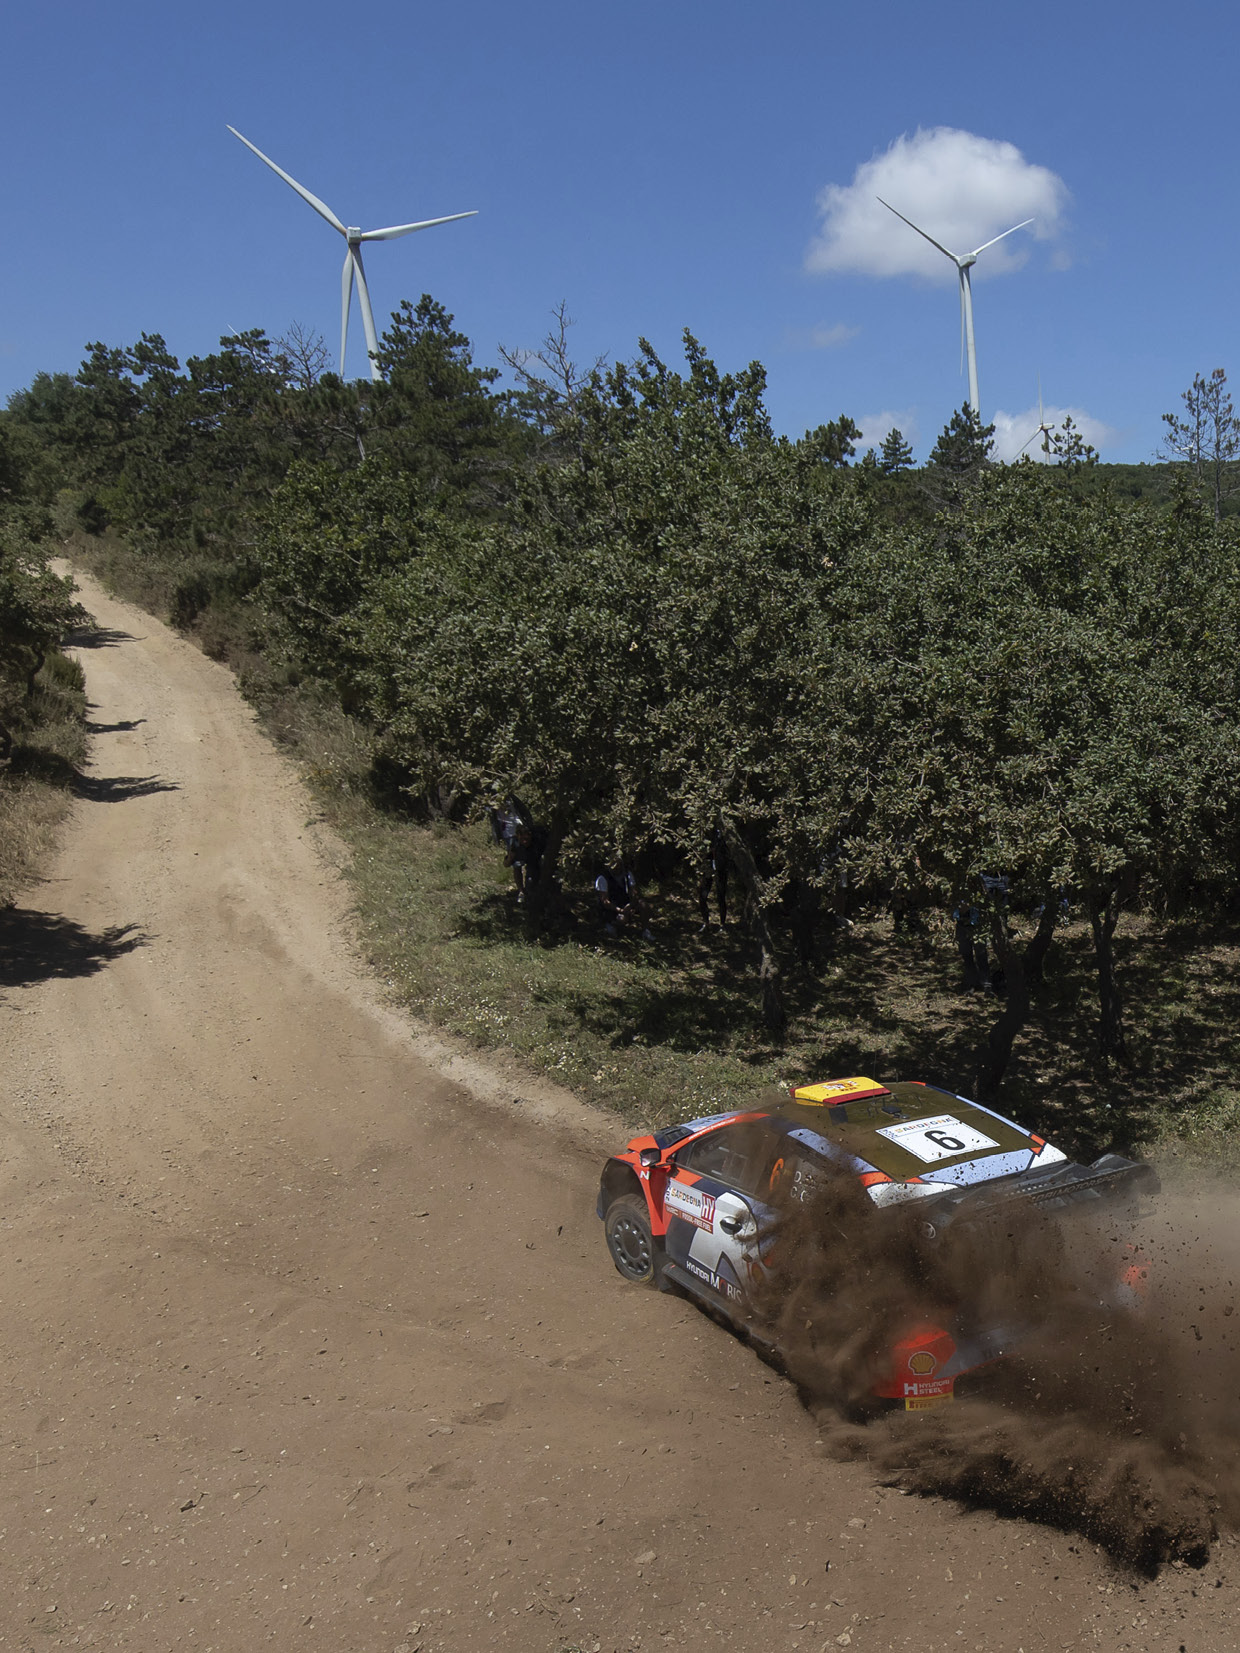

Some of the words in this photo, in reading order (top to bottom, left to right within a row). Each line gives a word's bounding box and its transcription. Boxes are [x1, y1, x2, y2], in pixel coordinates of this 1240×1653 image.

[924, 1130, 966, 1151] 6
[640, 1170, 650, 1181] N
[671, 1187, 702, 1208] SARDEGNA
[919, 1387, 943, 1395] STEEL
